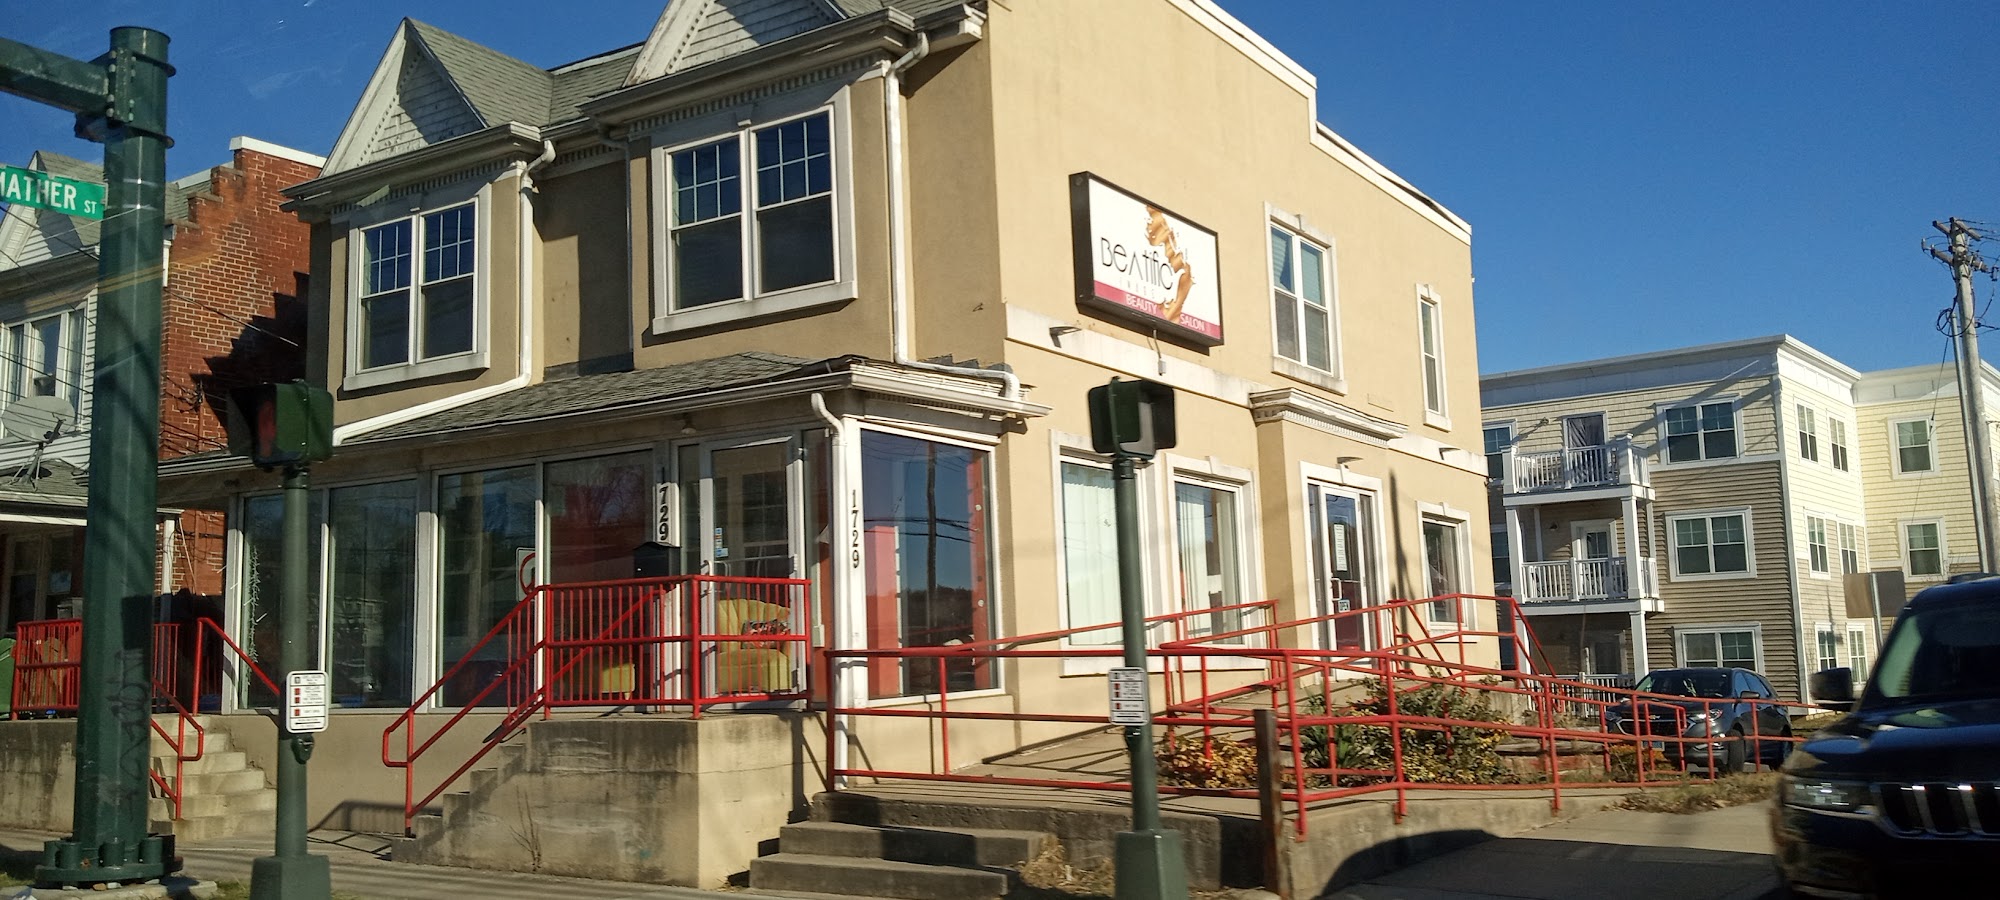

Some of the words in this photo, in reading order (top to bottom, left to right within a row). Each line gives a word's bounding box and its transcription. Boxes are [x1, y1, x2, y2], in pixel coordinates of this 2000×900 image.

[83, 199, 98, 215] ST
[1125, 293, 1158, 315] BEAUTY
[1180, 312, 1206, 333] SALON
[851, 489, 860, 569] 1729
